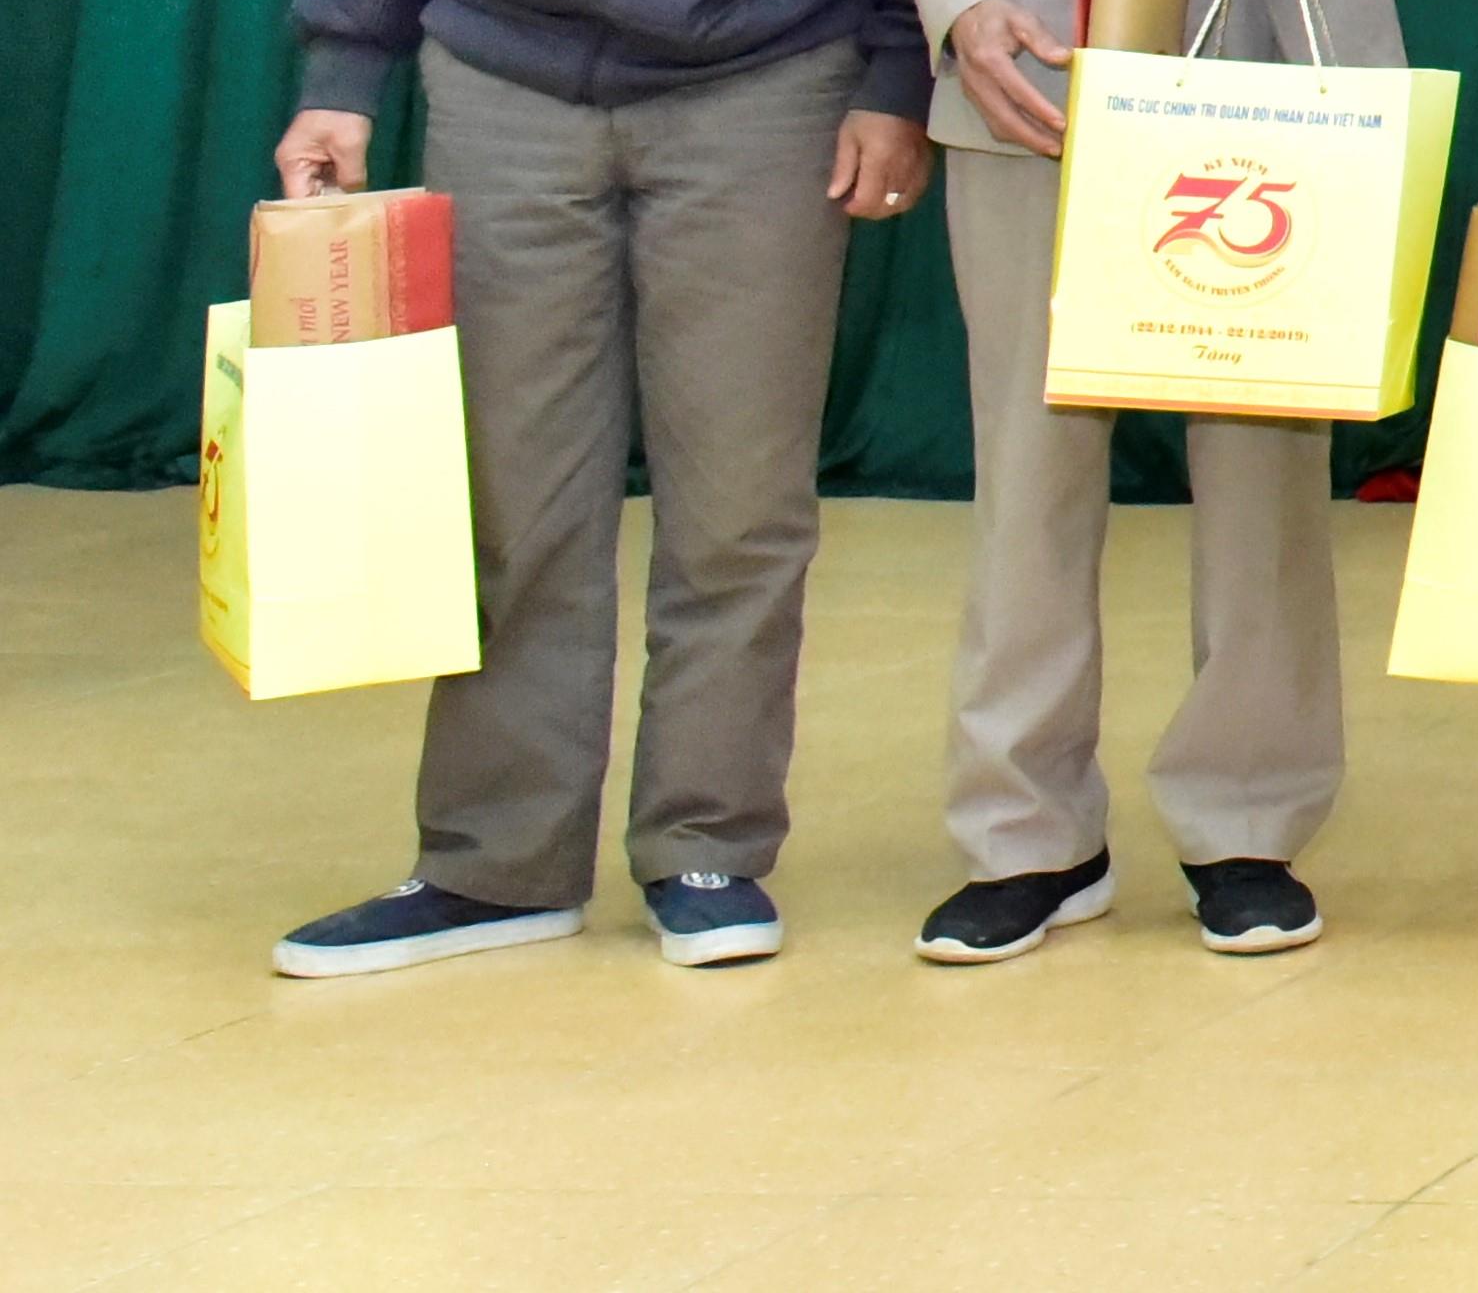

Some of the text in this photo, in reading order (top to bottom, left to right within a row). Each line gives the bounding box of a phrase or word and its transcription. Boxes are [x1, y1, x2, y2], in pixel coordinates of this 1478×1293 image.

[1358, 114, 1382, 128] NAM
[1152, 172, 1297, 255] 75
[330, 239, 350, 343] NEW YEAR
